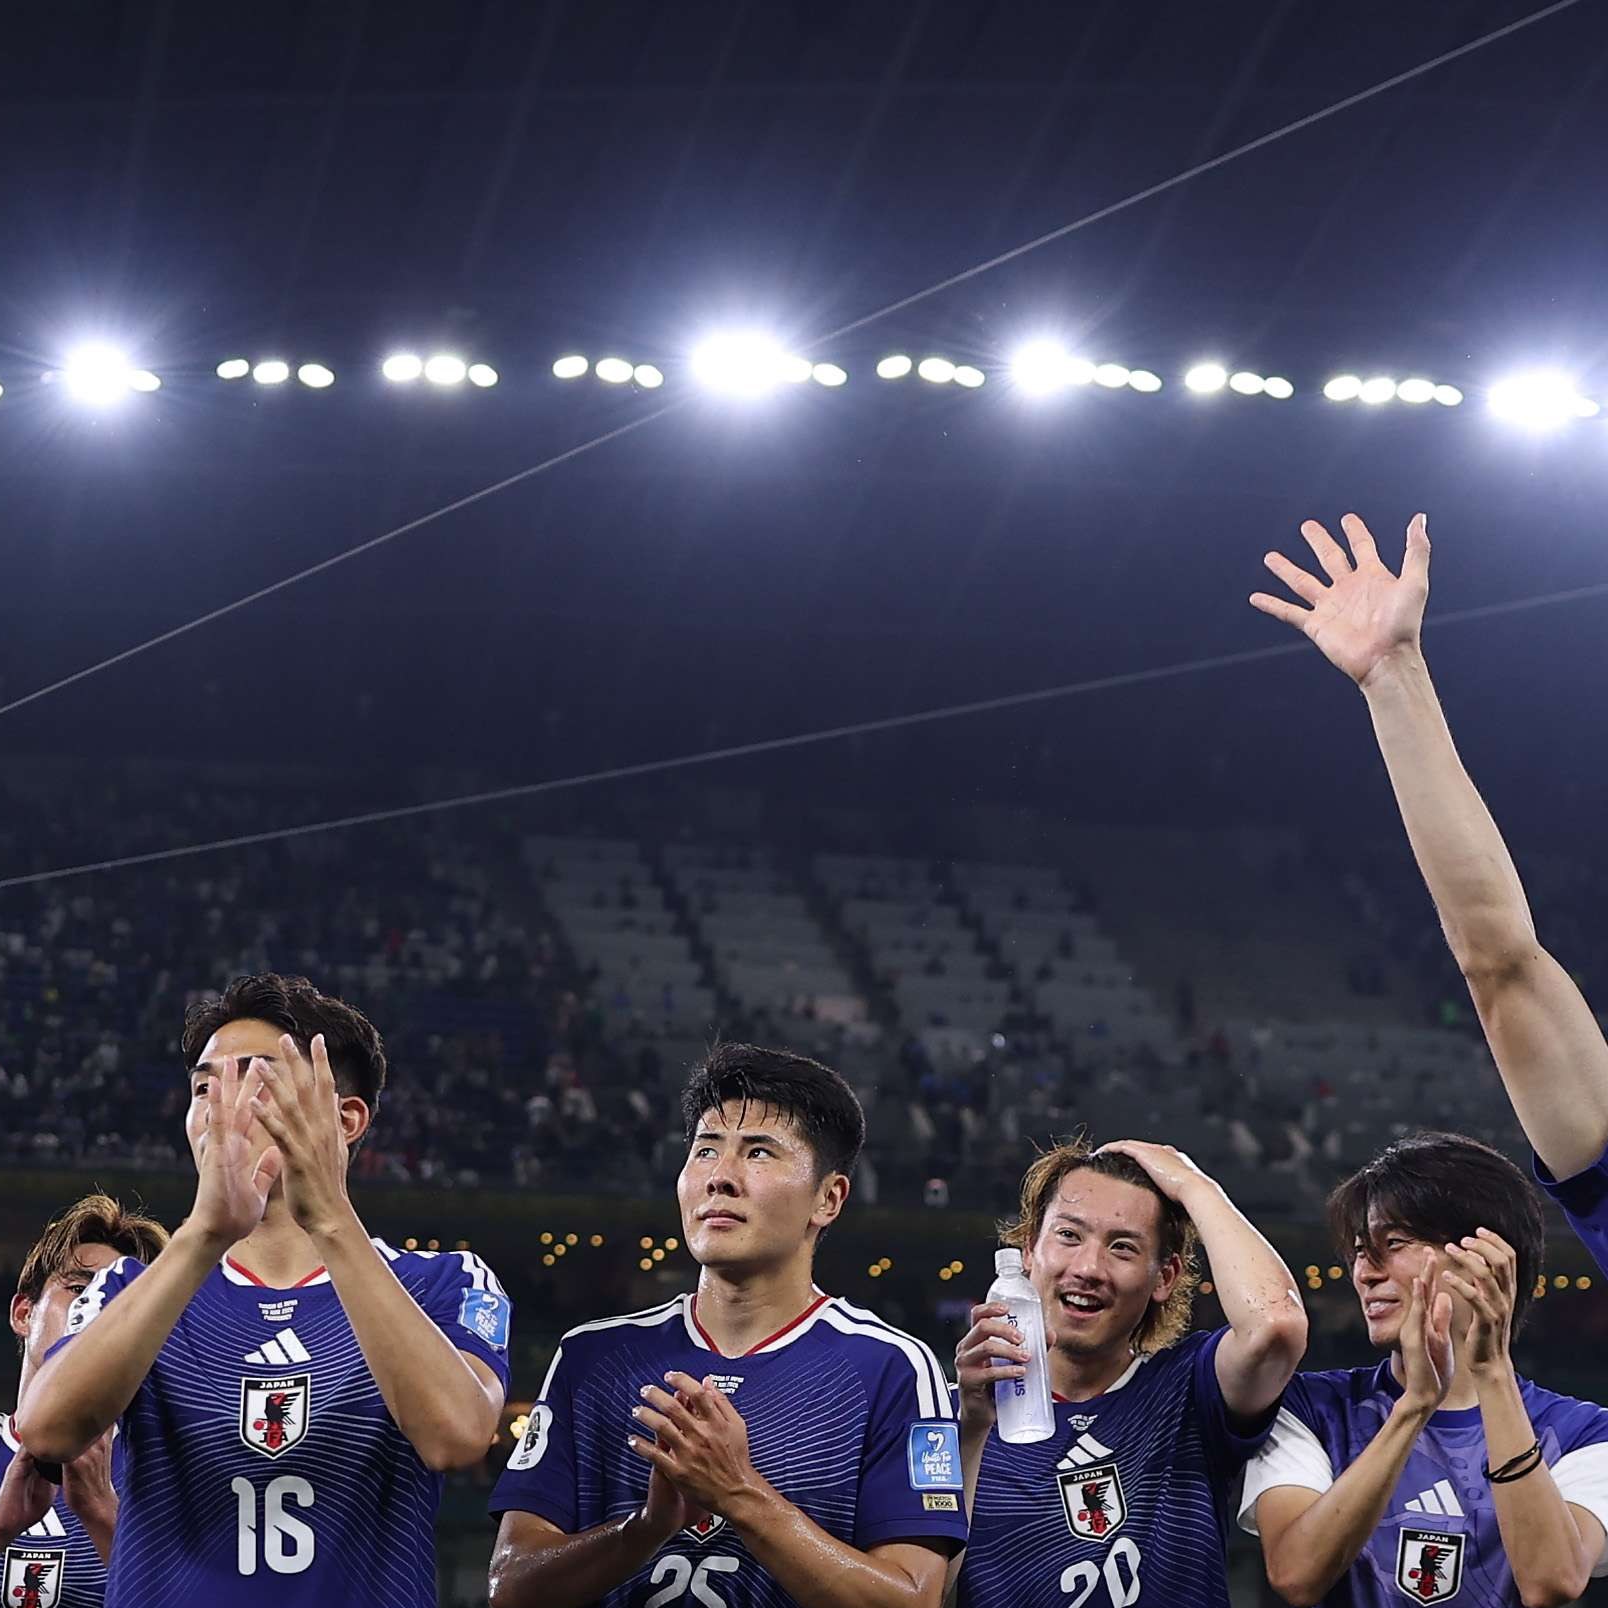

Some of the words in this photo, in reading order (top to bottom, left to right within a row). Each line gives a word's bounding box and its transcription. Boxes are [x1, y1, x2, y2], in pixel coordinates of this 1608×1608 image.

[259, 1380, 295, 1390] JAPAN
[924, 1463, 952, 1475] PEACE
[1073, 1470, 1104, 1482] JAPAN
[231, 1475, 315, 1575] 16
[1417, 1533, 1449, 1543] JAPAN
